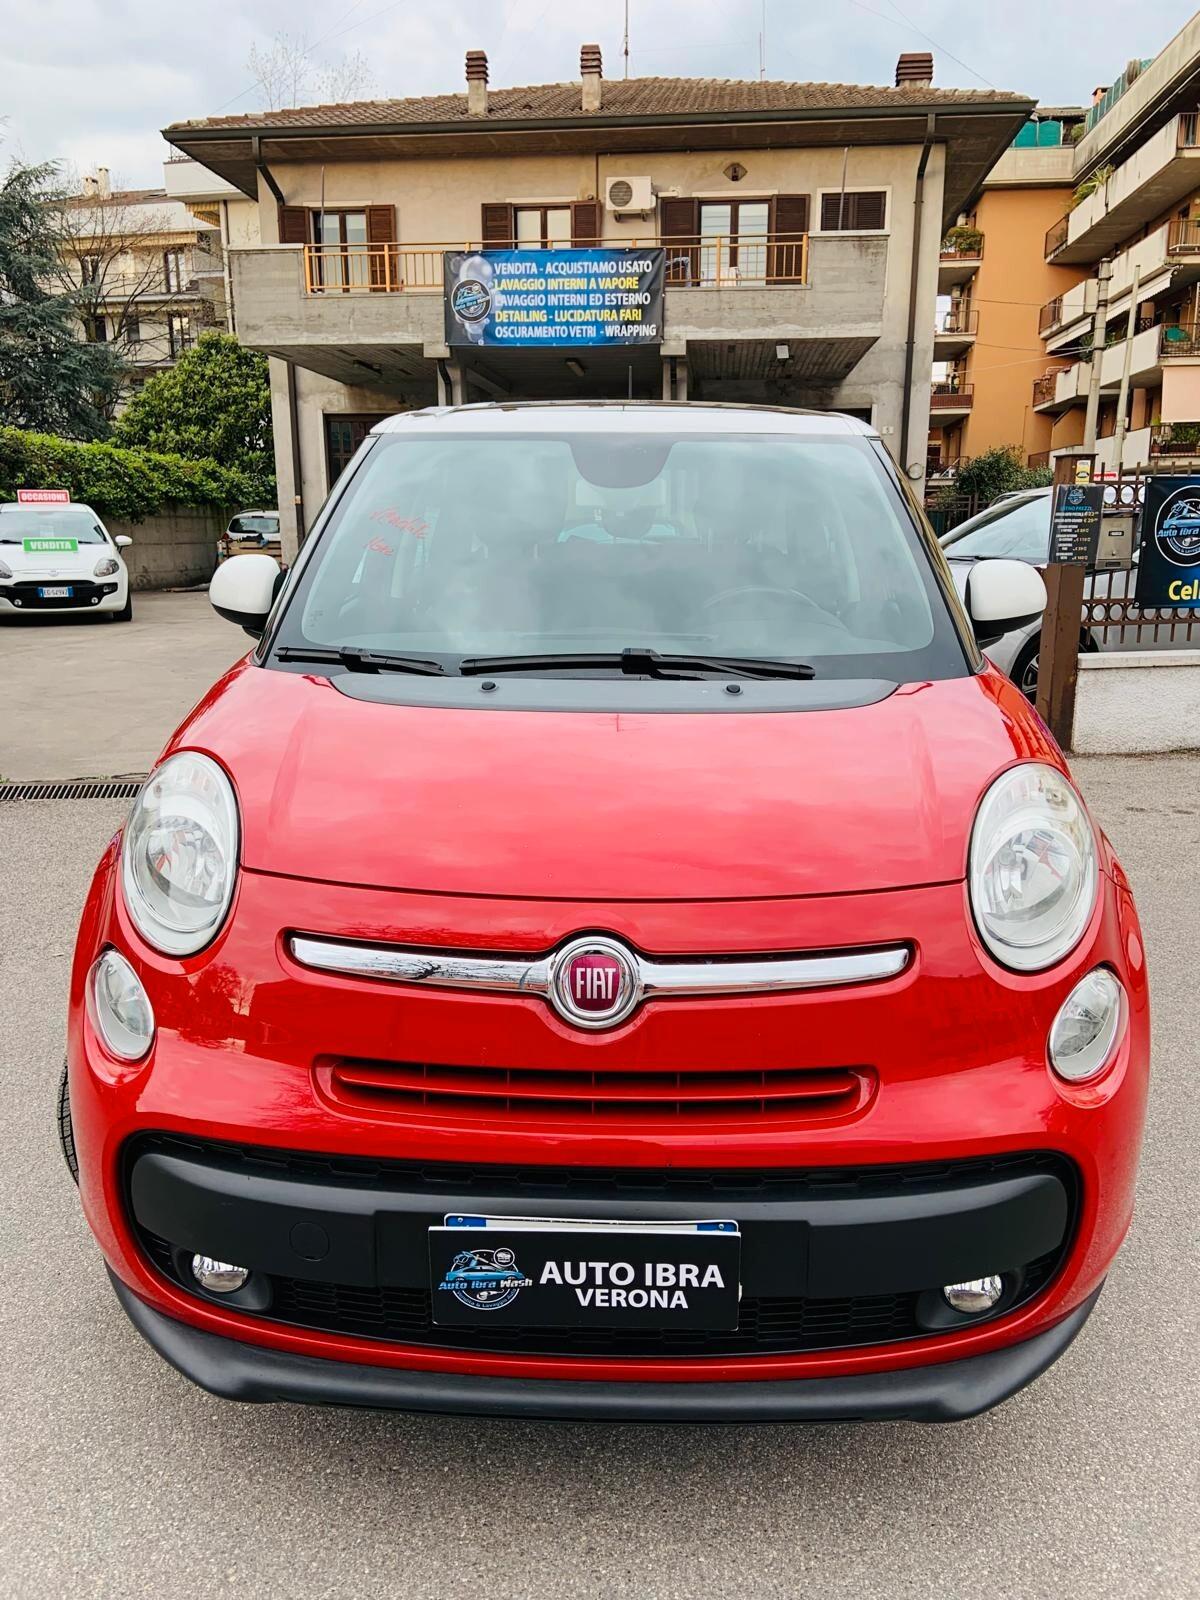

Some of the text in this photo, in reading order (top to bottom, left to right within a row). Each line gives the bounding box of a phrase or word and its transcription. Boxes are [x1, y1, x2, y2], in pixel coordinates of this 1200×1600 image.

[494, 262, 538, 275] VENDITA
[545, 261, 617, 275] ACQUISTIAMO
[618, 260, 652, 274] USATO
[494, 276, 639, 291] LAVAGGIO INTERNI A VAPORE
[494, 294, 546, 306] LAVAGGIO
[547, 293, 587, 306] INTERNI
[589, 293, 603, 306] ED
[604, 292, 651, 306] ESTERNO
[495, 309, 547, 323] DETAILING
[554, 309, 618, 322] LUCIDATURA
[620, 308, 642, 321] FARI
[494, 325, 569, 338] OSCURAMENTO
[569, 325, 597, 338] VETRI
[605, 324, 657, 337] WRAPPING
[21, 492, 67, 501] OCCASIONE
[1157, 528, 1178, 538] Auto
[30, 540, 72, 550] VENDITA
[1168, 579, 1200, 601] Cel
[576, 967, 616, 999] FIAT
[539, 1261, 725, 1288] AUTO IBRA
[438, 1278, 533, 1290] Auto Ibra Wash
[575, 1288, 688, 1309] VERONA
